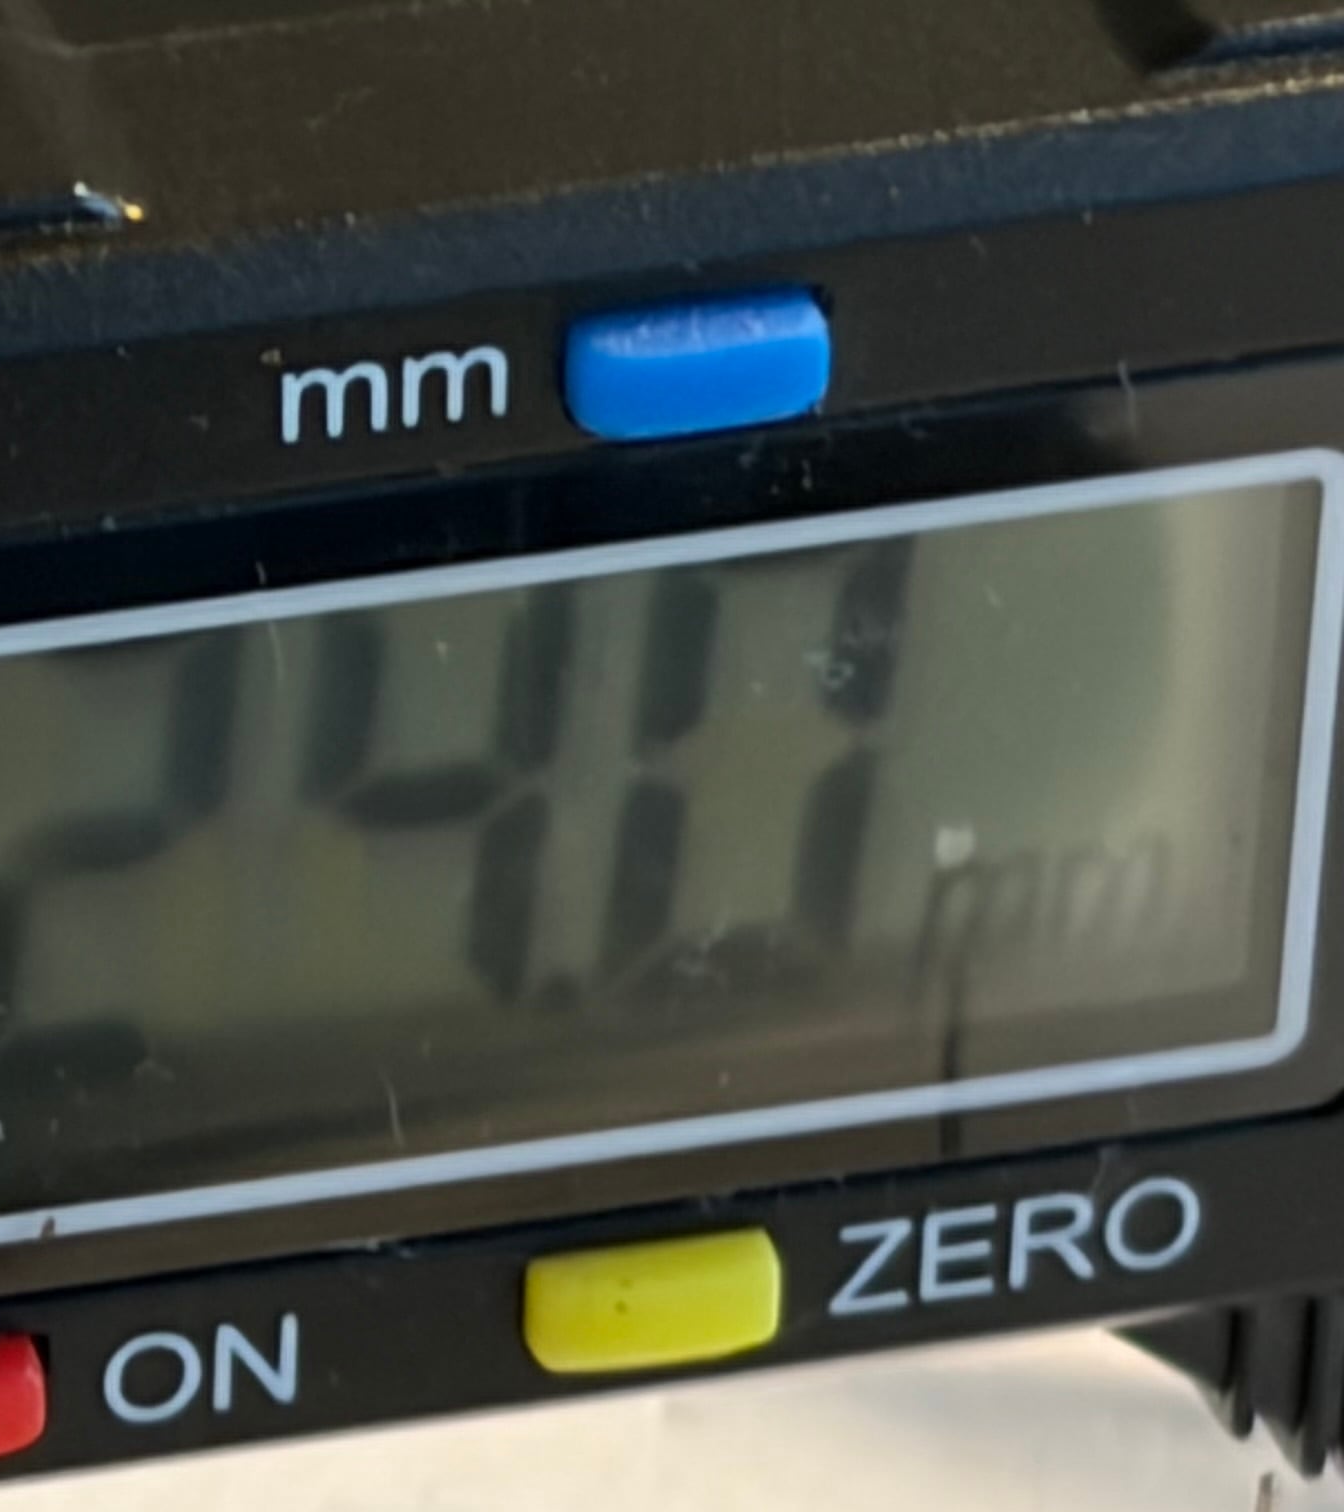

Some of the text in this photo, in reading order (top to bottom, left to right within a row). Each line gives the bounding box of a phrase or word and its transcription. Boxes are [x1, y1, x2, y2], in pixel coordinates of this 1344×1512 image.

[281, 346, 508, 443] mm
[103, 1313, 299, 1424] ON
[829, 1176, 1200, 1316] ZERO
